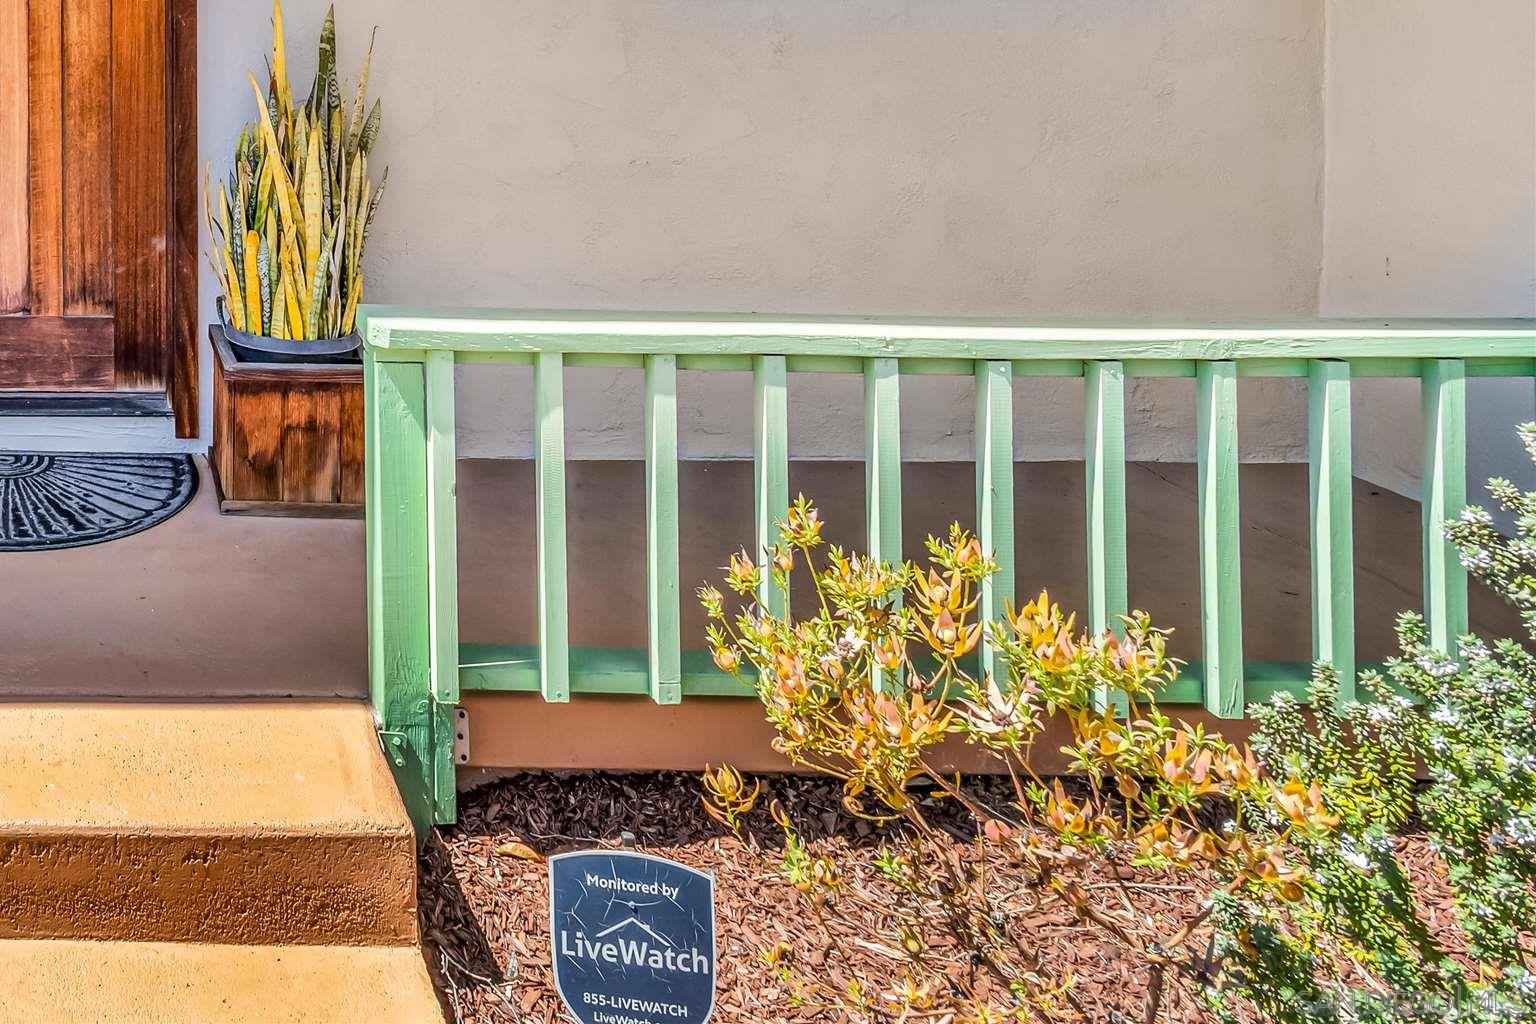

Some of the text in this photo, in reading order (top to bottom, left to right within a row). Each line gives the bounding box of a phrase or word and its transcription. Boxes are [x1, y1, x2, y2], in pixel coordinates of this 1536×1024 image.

[586, 873, 679, 899] Monitored by
[561, 930, 709, 975] LiveWatch
[583, 992, 688, 1018] 855-LIVEWATCH
